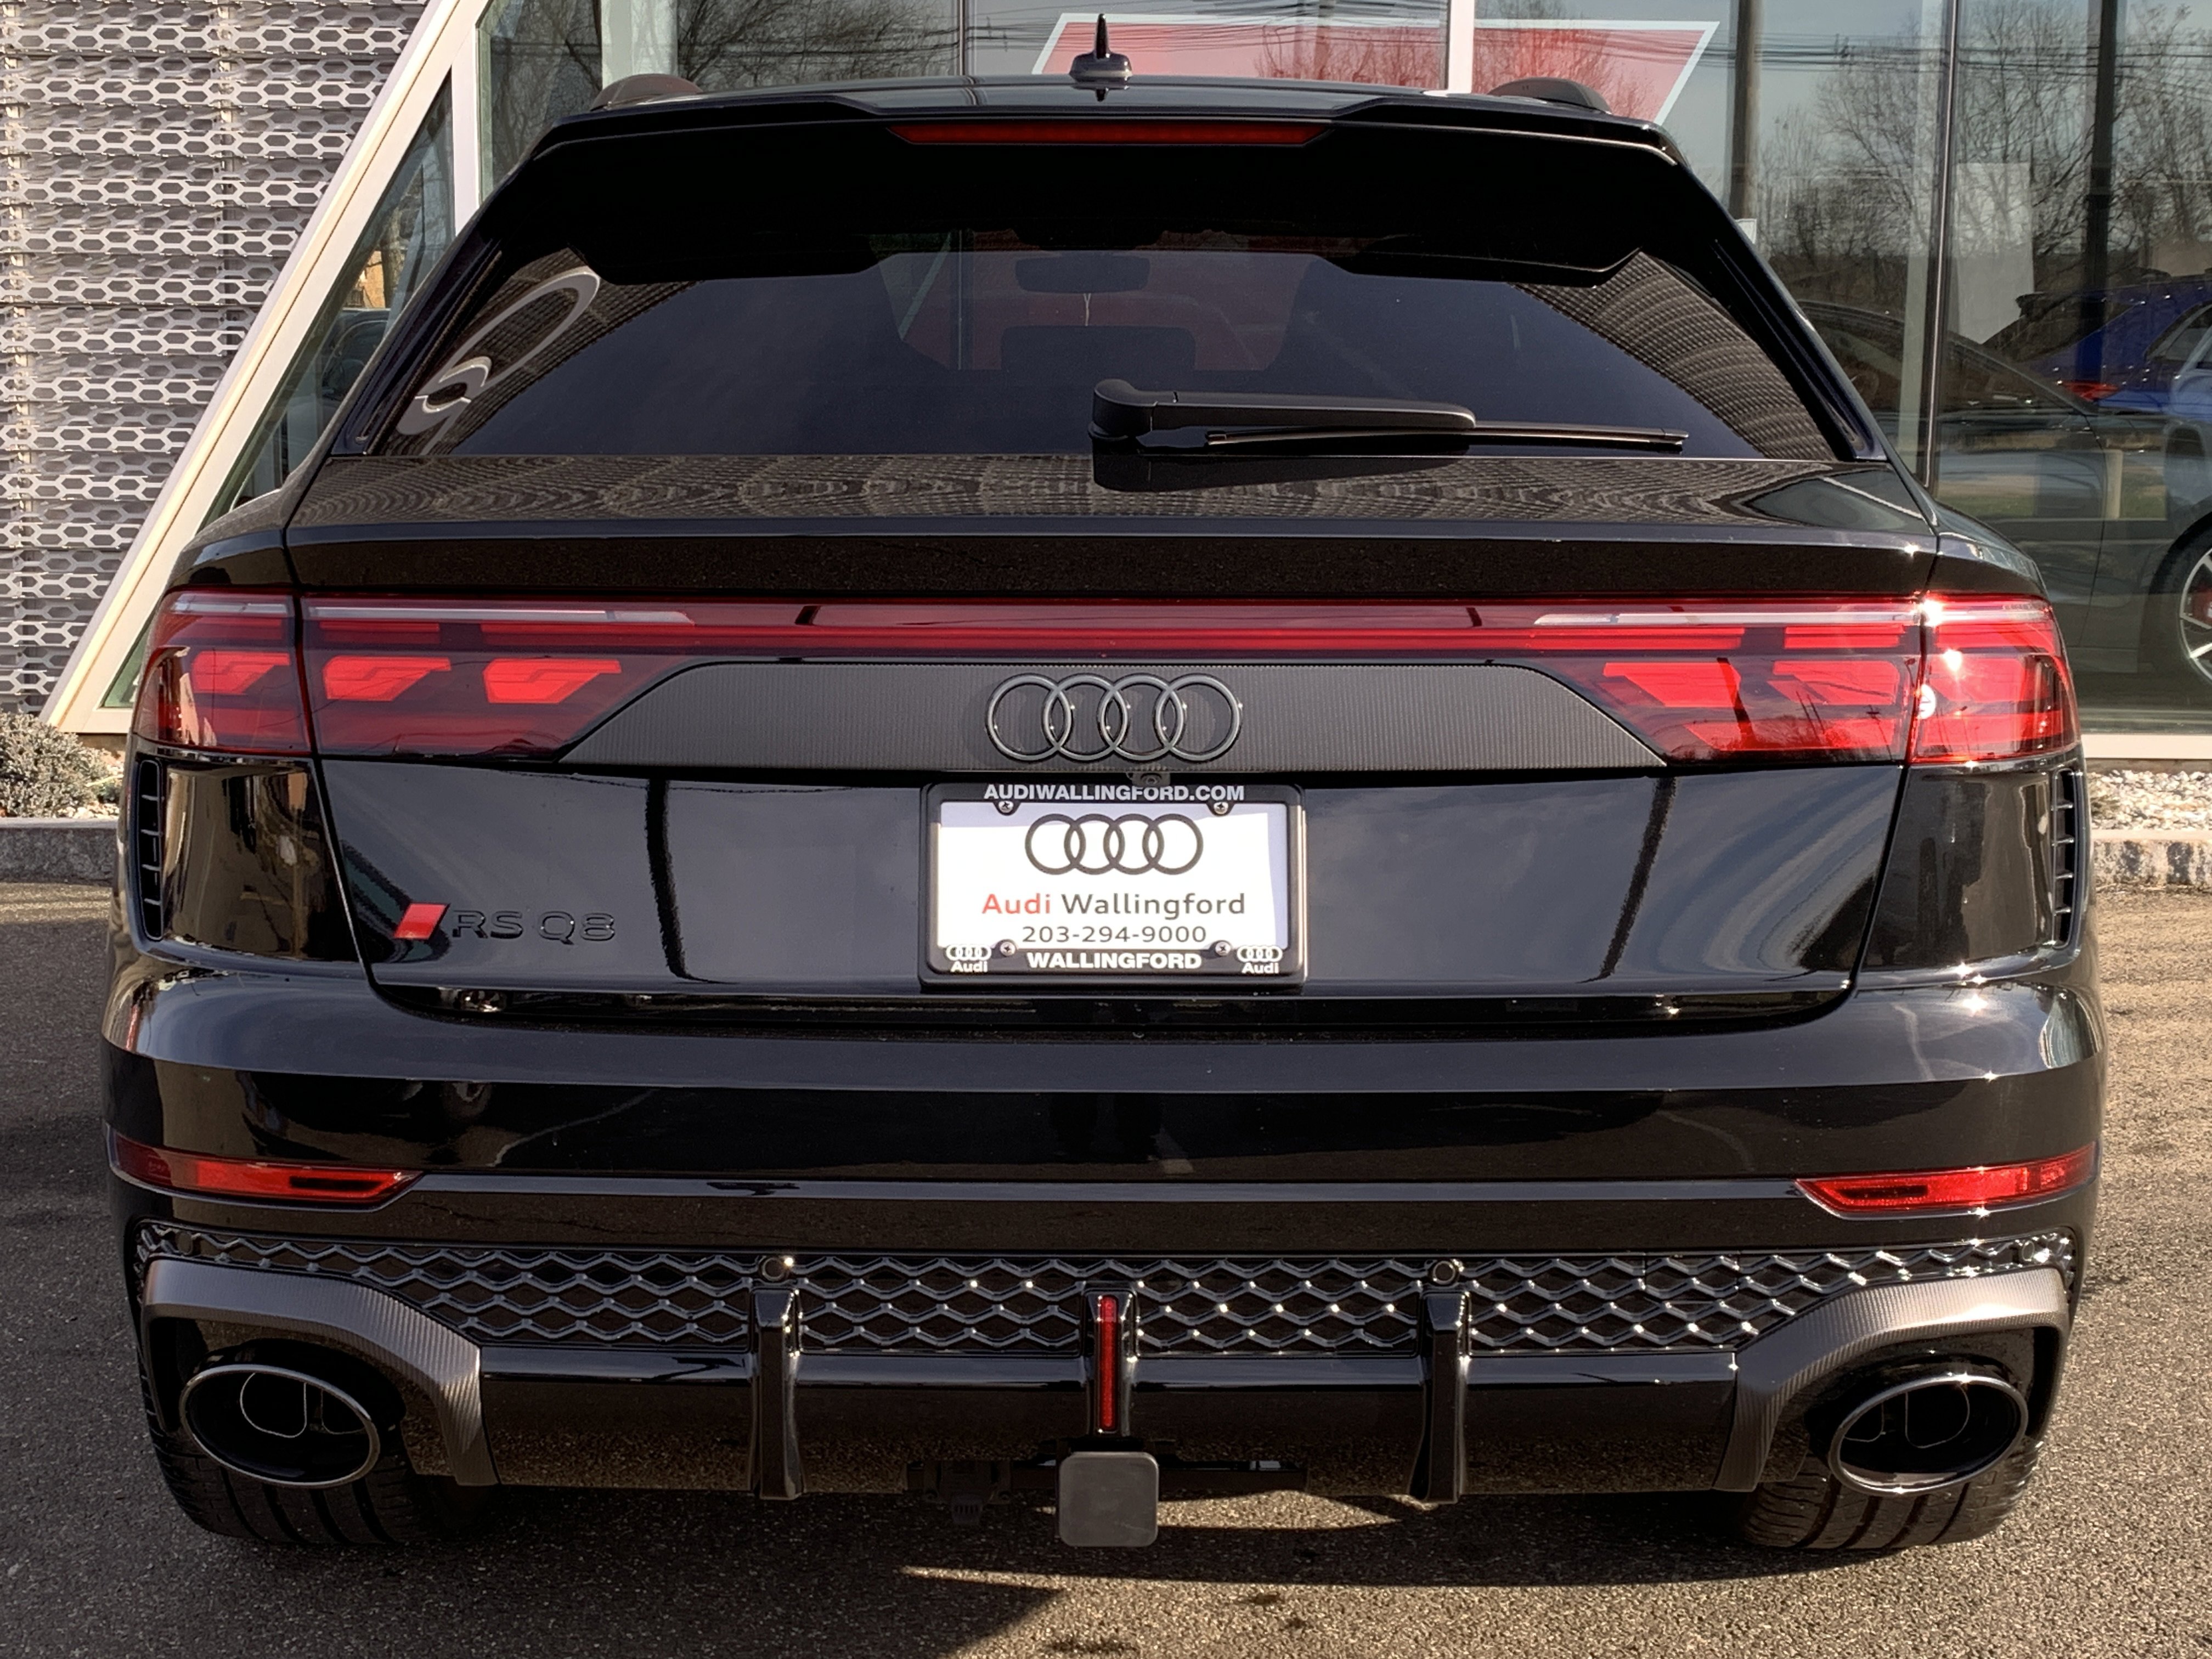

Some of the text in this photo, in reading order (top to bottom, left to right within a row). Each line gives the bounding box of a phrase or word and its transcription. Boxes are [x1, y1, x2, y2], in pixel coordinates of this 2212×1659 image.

[984, 785, 1244, 800] AUDIWALLINGFORD.COM
[982, 893, 1244, 920] Audi Wallingford
[452, 911, 615, 945] RS Q8
[1022, 926, 1206, 943] 203-294-9000
[951, 961, 988, 973] Audi
[1028, 953, 1201, 969] WALLINGFORD
[1242, 962, 1279, 974] Audi
